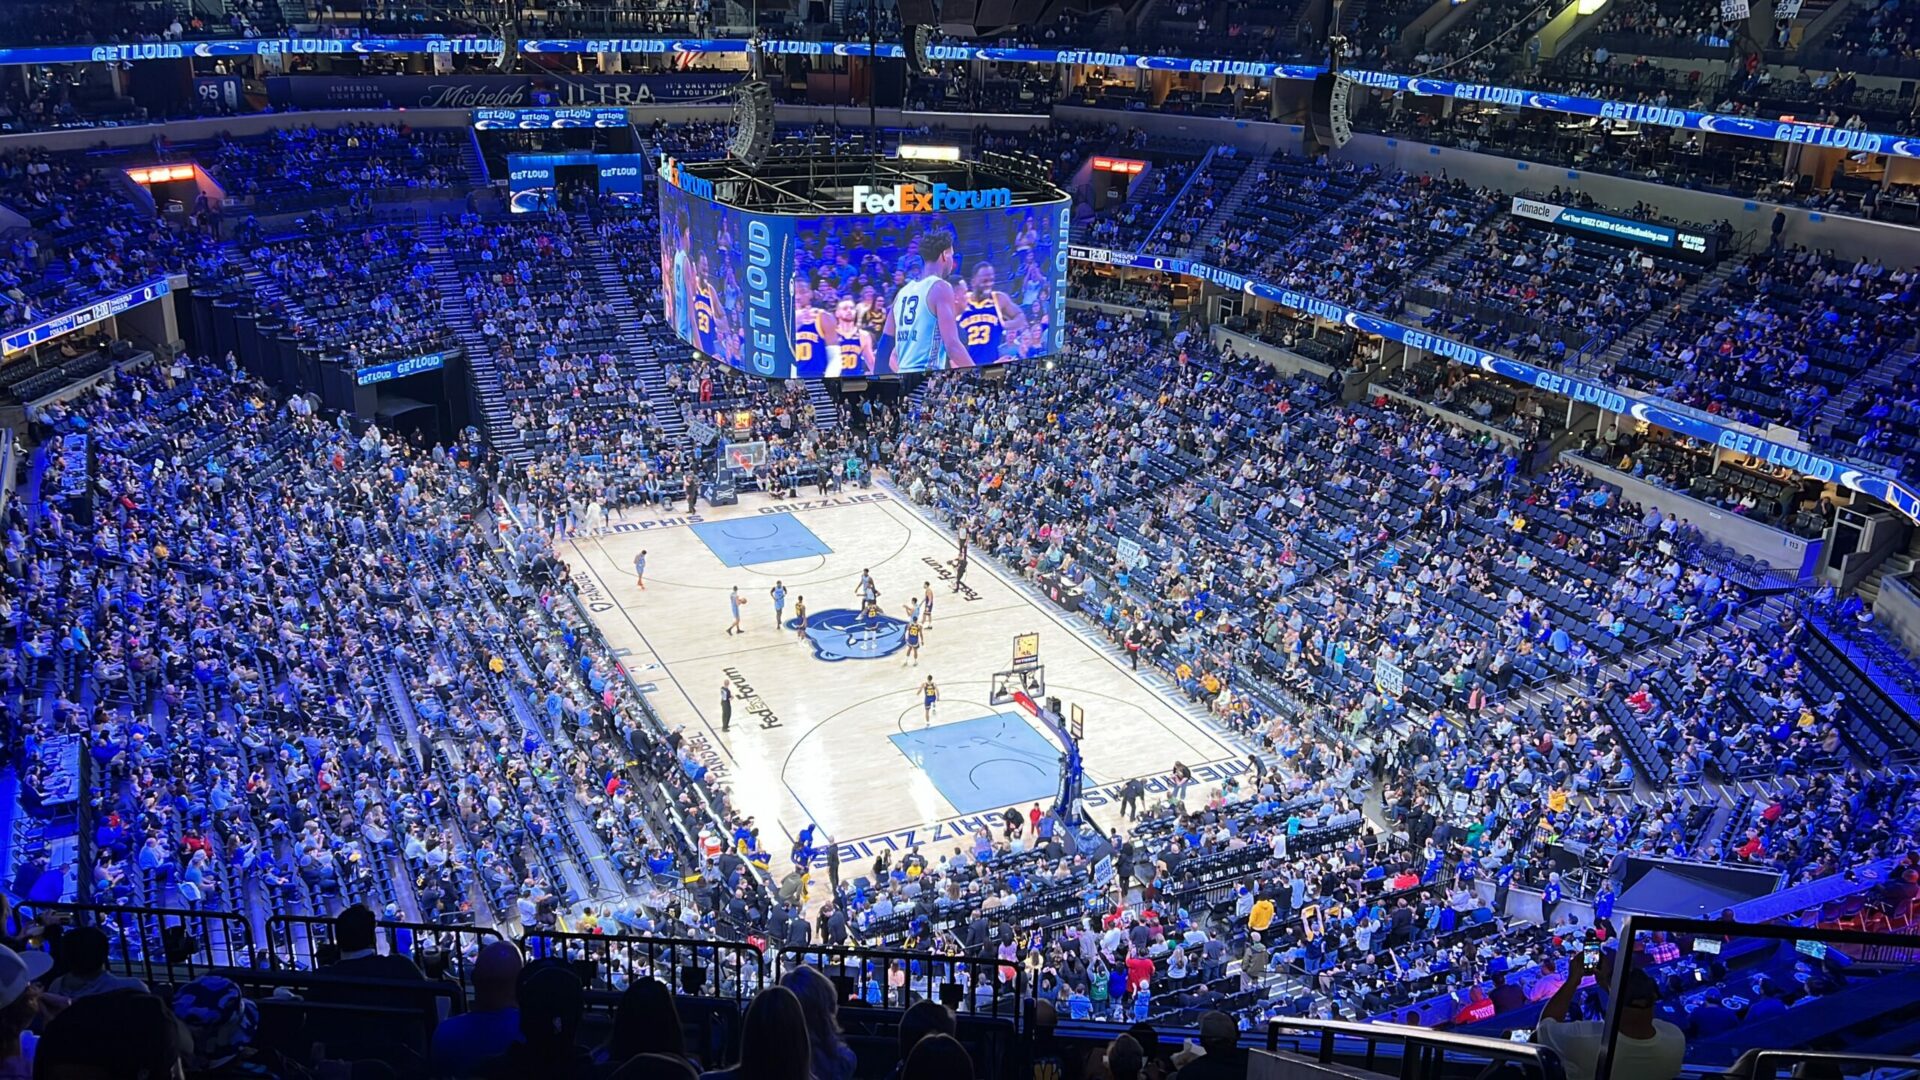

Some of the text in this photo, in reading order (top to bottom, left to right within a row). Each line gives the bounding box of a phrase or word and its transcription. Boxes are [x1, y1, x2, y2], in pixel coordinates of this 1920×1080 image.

[1721, 11, 1750, 21] MANE
[91, 44, 183, 62] GET LOUD
[257, 39, 343, 55] GET LOUD
[426, 39, 462, 54] GET
[586, 39, 665, 54] GET LOUD
[778, 41, 821, 55] LOUD
[1056, 51, 1126, 67] GET LOUD
[1190, 60, 1266, 77] GET LOUD
[1366, 71, 1399, 90] LOUD
[199, 85, 218, 100] 95
[328, 92, 359, 100] LIGHT
[330, 85, 379, 93] SUPERIOR
[419, 83, 527, 108] Michelob
[1454, 84, 1523, 107] GET LOUD
[477, 110, 516, 121] GET LOUD
[534, 113, 550, 121] LOUD
[554, 109, 591, 119] GET LOUD
[597, 112, 624, 120] GET LOUD
[1600, 102, 1686, 128] GET LOUD
[1774, 124, 1882, 154] GET LOUD
[510, 169, 549, 180] GET LOUD
[601, 166, 637, 178] GET LOUD
[852, 182, 1013, 214] FedExForum
[1516, 199, 1551, 217] Pinnacle
[1561, 212, 1570, 222] Get
[1570, 214, 1581, 225] Your
[1595, 217, 1610, 230] CARD
[1154, 258, 1163, 270] 0
[1054, 208, 1071, 349] GET LOUD
[144, 287, 152, 301] 0
[746, 220, 776, 376] GET LOUD
[898, 295, 920, 327] 13
[28, 330, 37, 343] 0
[967, 325, 991, 346] 23
[397, 355, 440, 374] GET LOUD
[358, 370, 392, 386] GET LOUD
[1773, 442, 1834, 482] LOUD
[758, 492, 889, 515] GRIZZLIES
[1788, 540, 1799, 550] 113
[921, 556, 984, 602] FedForum
